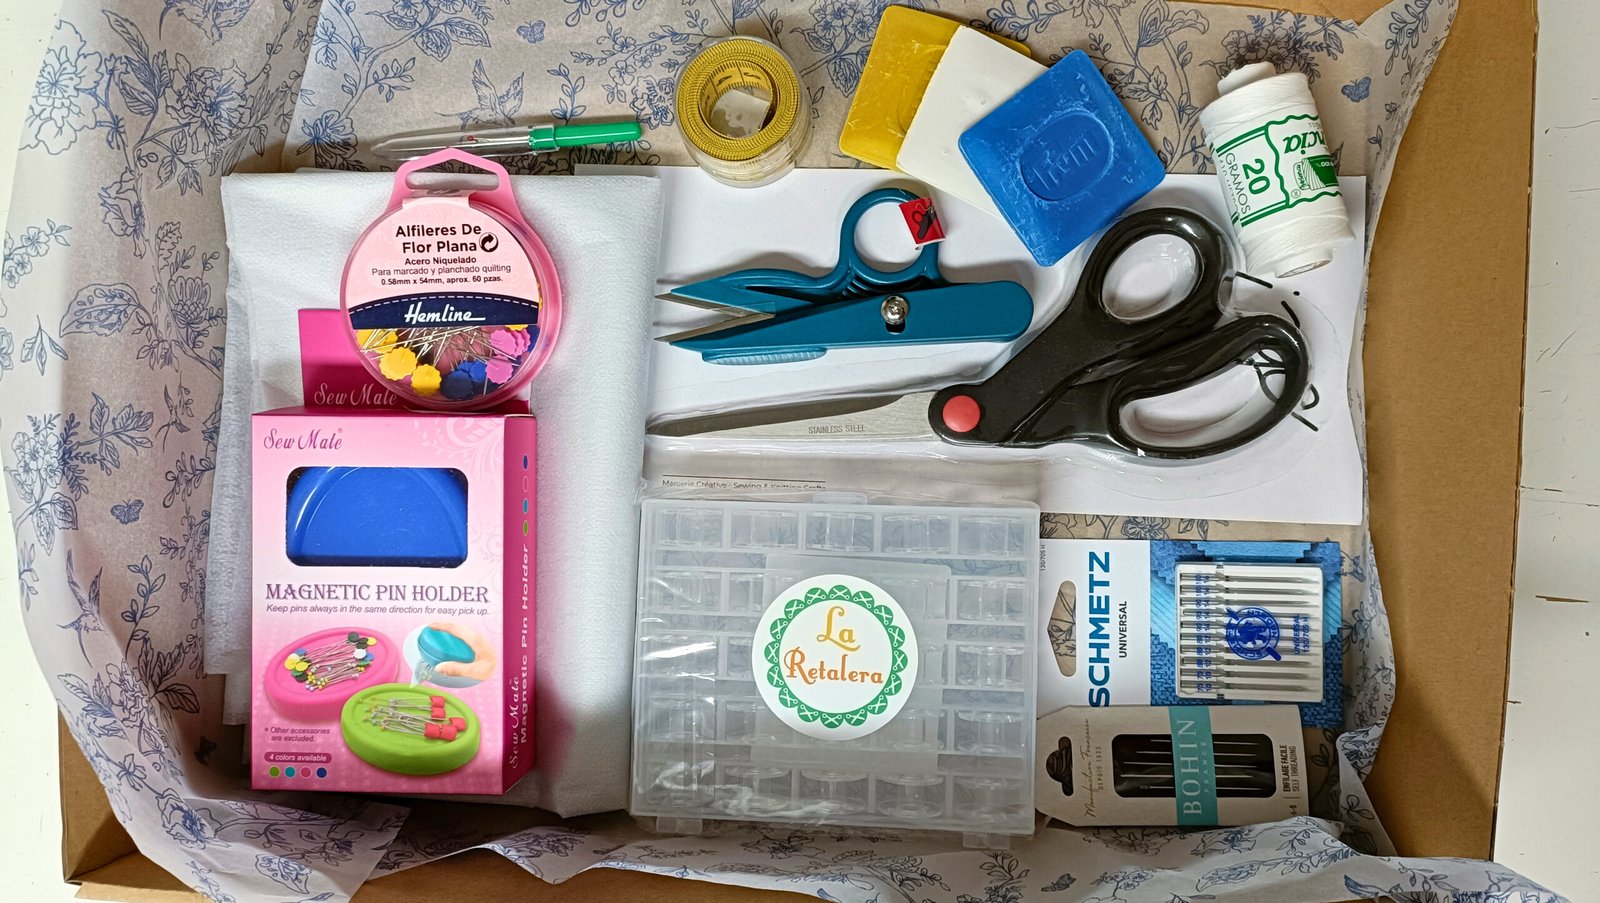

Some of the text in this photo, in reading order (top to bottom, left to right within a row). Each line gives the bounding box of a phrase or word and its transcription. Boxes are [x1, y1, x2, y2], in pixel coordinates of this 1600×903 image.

[1225, 152, 1250, 214] GRAMOS
[1242, 158, 1270, 195] 20
[395, 224, 482, 238] Alfileres De
[402, 240, 477, 254] Flor Plana
[372, 264, 512, 276] Para marcado y planchado quilting
[405, 256, 477, 266] Acero Niquelado
[419, 277, 445, 285] 54mm,
[446, 276, 470, 284] aprox.
[484, 276, 503, 284] pzas.
[404, 302, 486, 324] Hemline
[314, 382, 397, 406] Sew Mate
[264, 428, 295, 450] Sew
[808, 424, 865, 434] STAINLESS STEEL
[266, 584, 490, 603] MAGNETIC PIN HOLDER
[266, 604, 289, 614] Keep
[290, 605, 308, 614] pins
[310, 604, 338, 614] always
[390, 606, 422, 614] direction
[424, 606, 436, 614] for
[437, 608, 456, 616] easy
[458, 606, 475, 615] pick
[816, 606, 860, 652] La
[1088, 552, 1110, 707] SCHMETZ
[1119, 601, 1128, 658] UNIVERSAL
[784, 646, 884, 684] Retalera
[520, 654, 528, 744] Magnetic
[270, 726, 289, 734] Other
[296, 754, 327, 762] available
[1177, 720, 1202, 814] BOHIN
[1201, 742, 1209, 792] FRANCE
[1280, 744, 1290, 792] ENFILAGE FACILE
[1291, 778, 1300, 792] SELF
